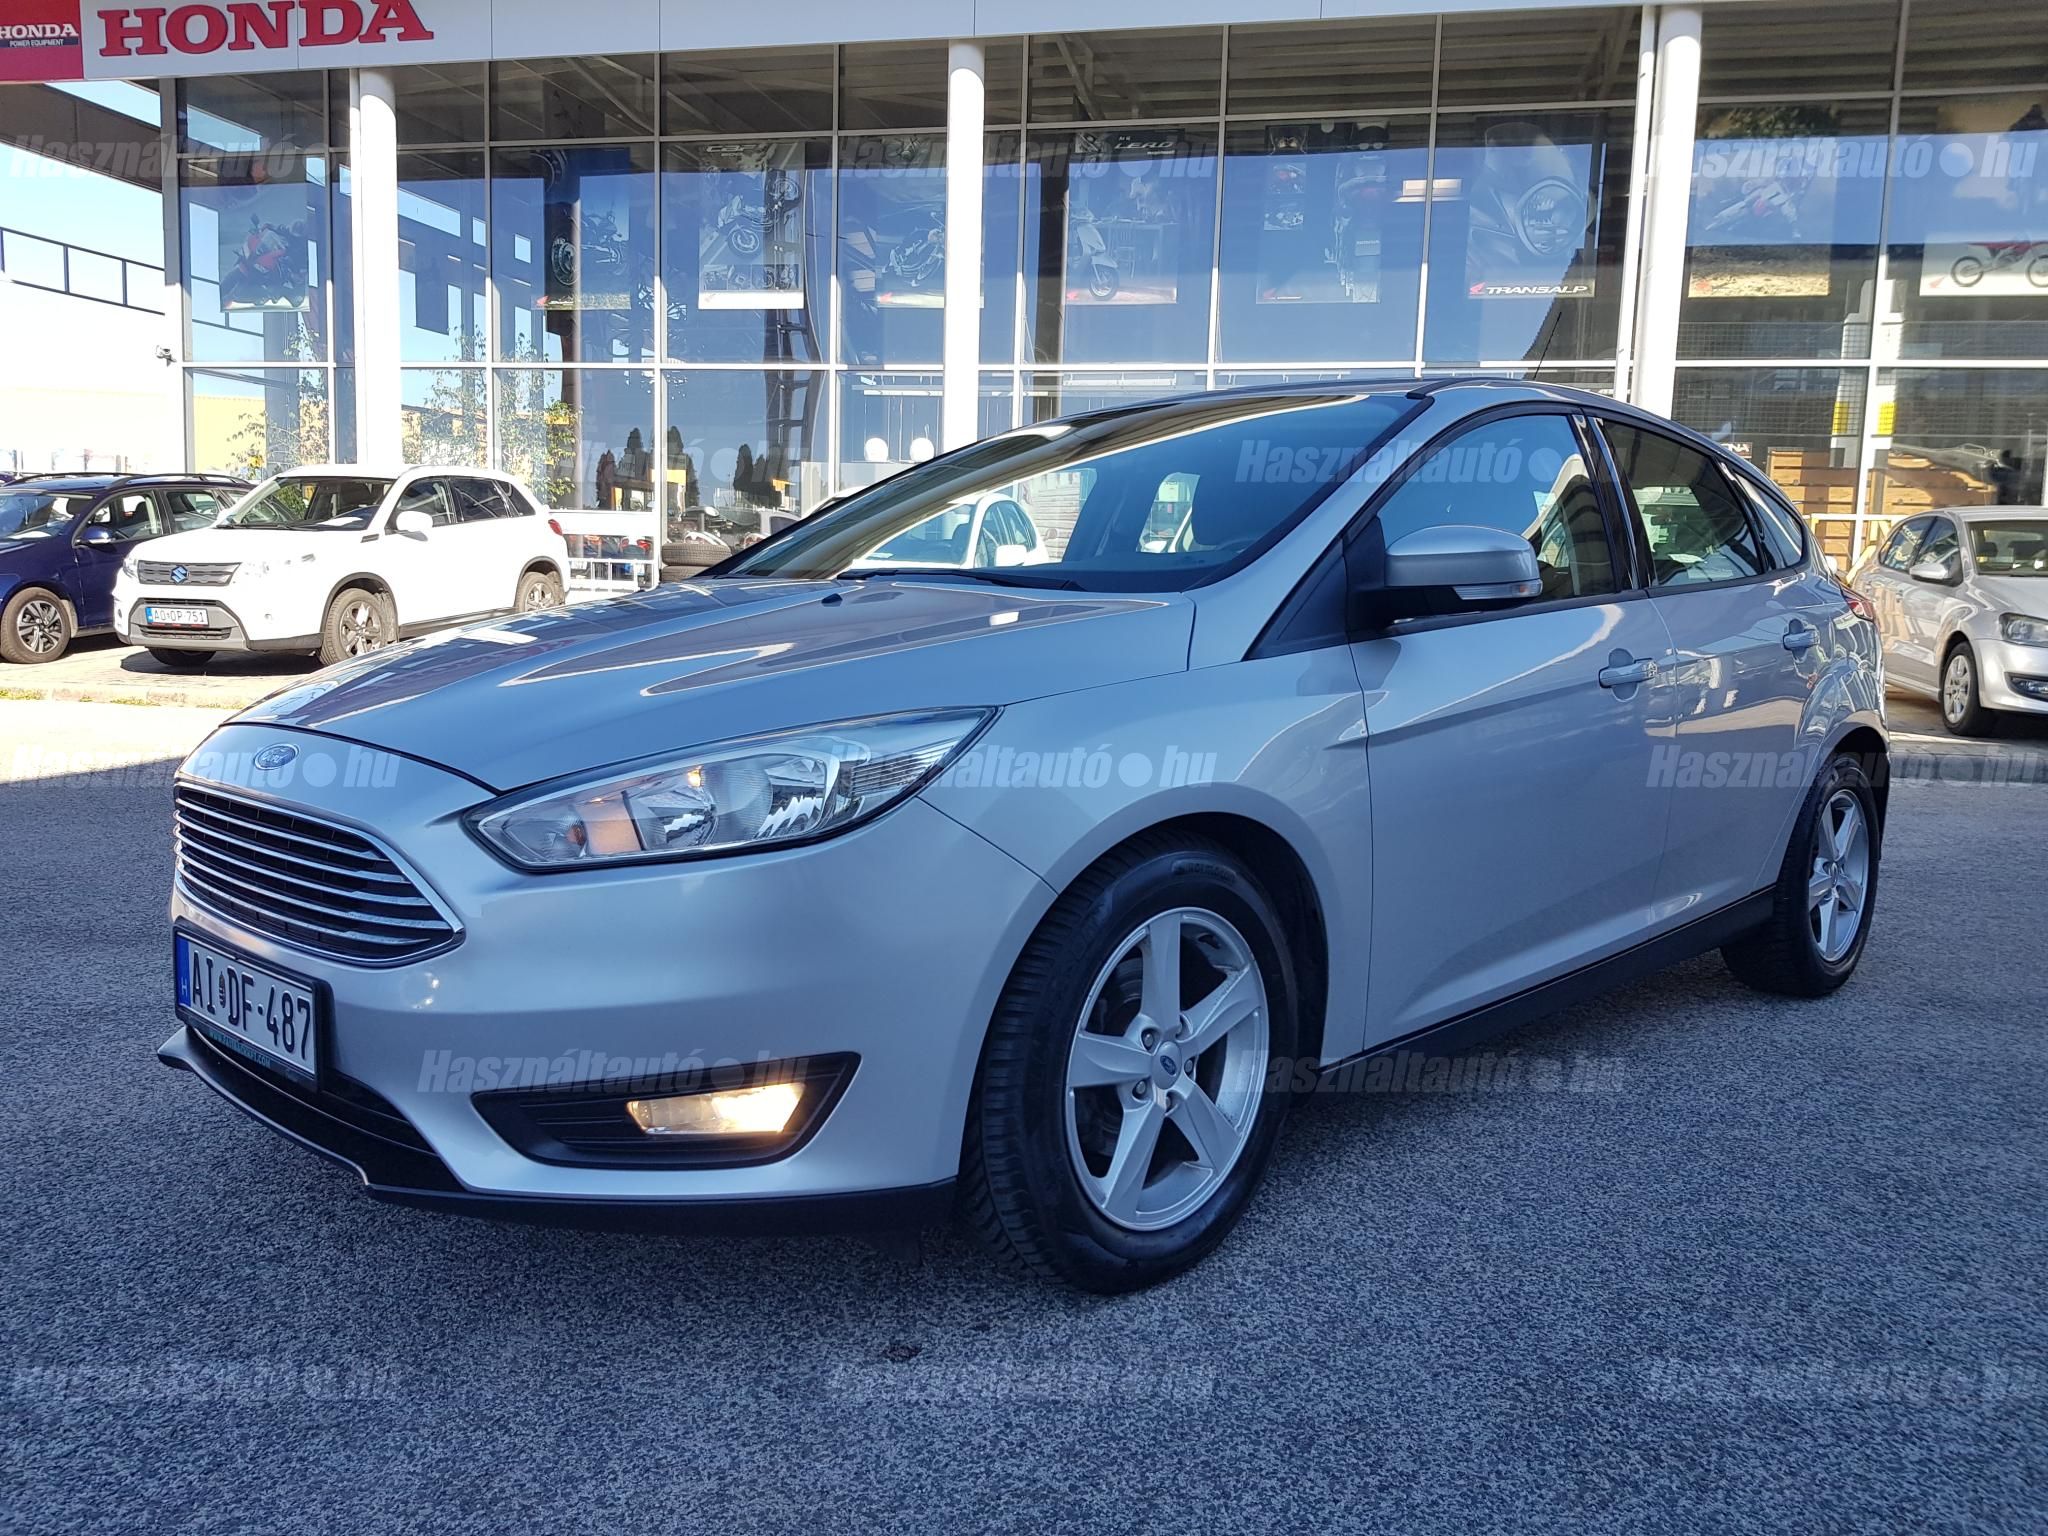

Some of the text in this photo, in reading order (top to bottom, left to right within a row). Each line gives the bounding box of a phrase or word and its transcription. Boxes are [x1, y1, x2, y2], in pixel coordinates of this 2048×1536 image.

[0, 23, 79, 39] HONDA
[98, 0, 434, 57] HONDA
[31, 38, 64, 46] EQUIPMENT
[1486, 285, 1588, 294] TRANSALP
